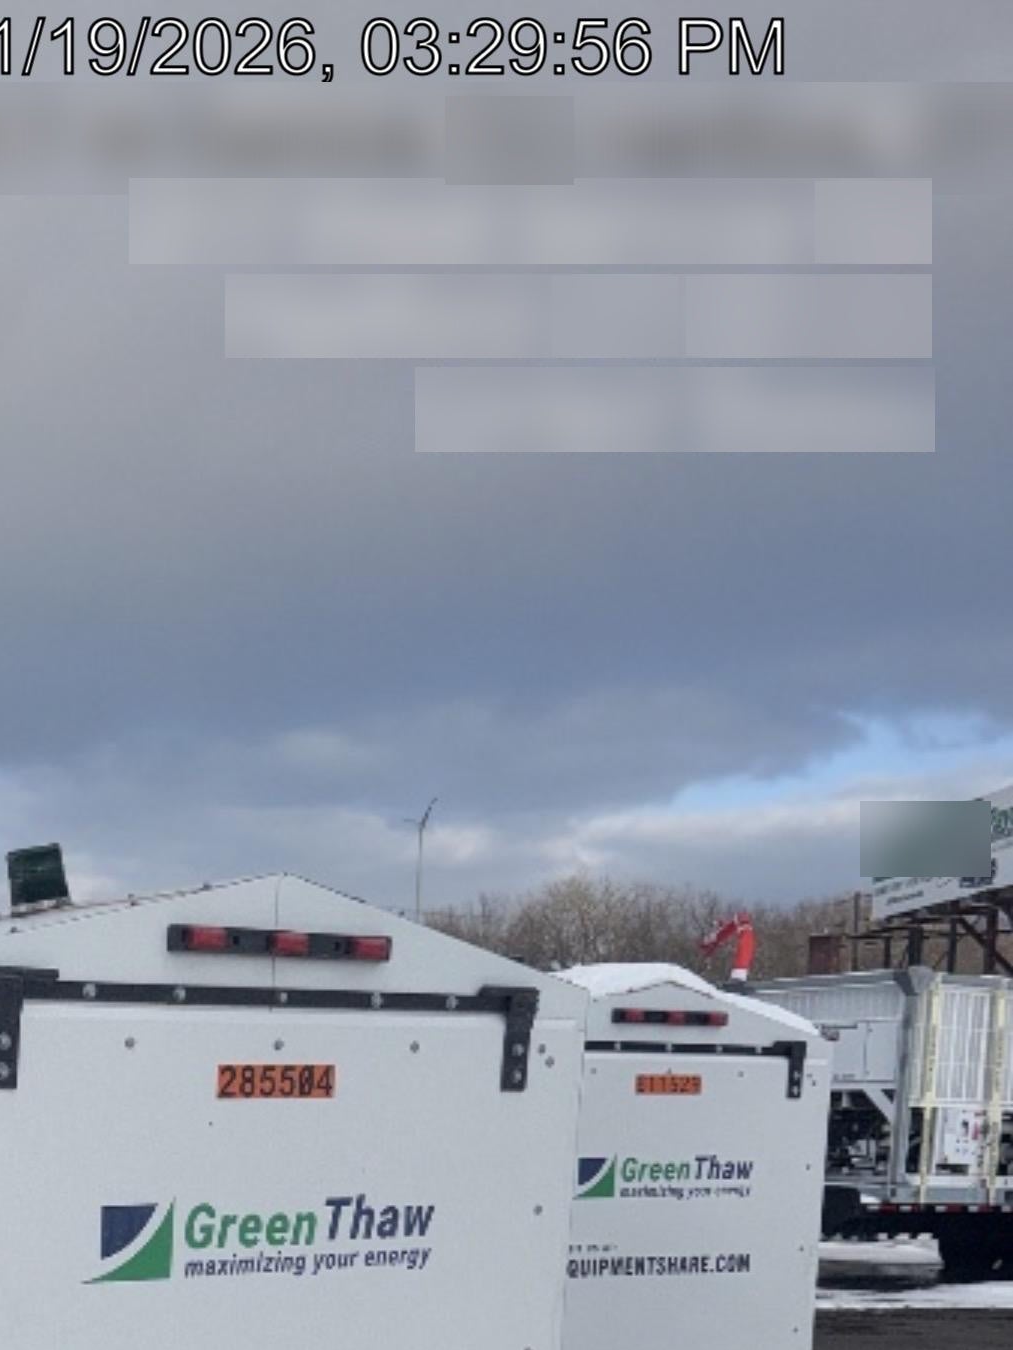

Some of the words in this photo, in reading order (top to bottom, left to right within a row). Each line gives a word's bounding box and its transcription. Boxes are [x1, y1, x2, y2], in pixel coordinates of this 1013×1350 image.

[218, 1064, 333, 1098] 285504
[185, 1251, 306, 1278] maximizing
[312, 1252, 358, 1275] your
[365, 1248, 432, 1269] energy
[566, 1253, 750, 1278] QUIPMENTSHARE.COM
